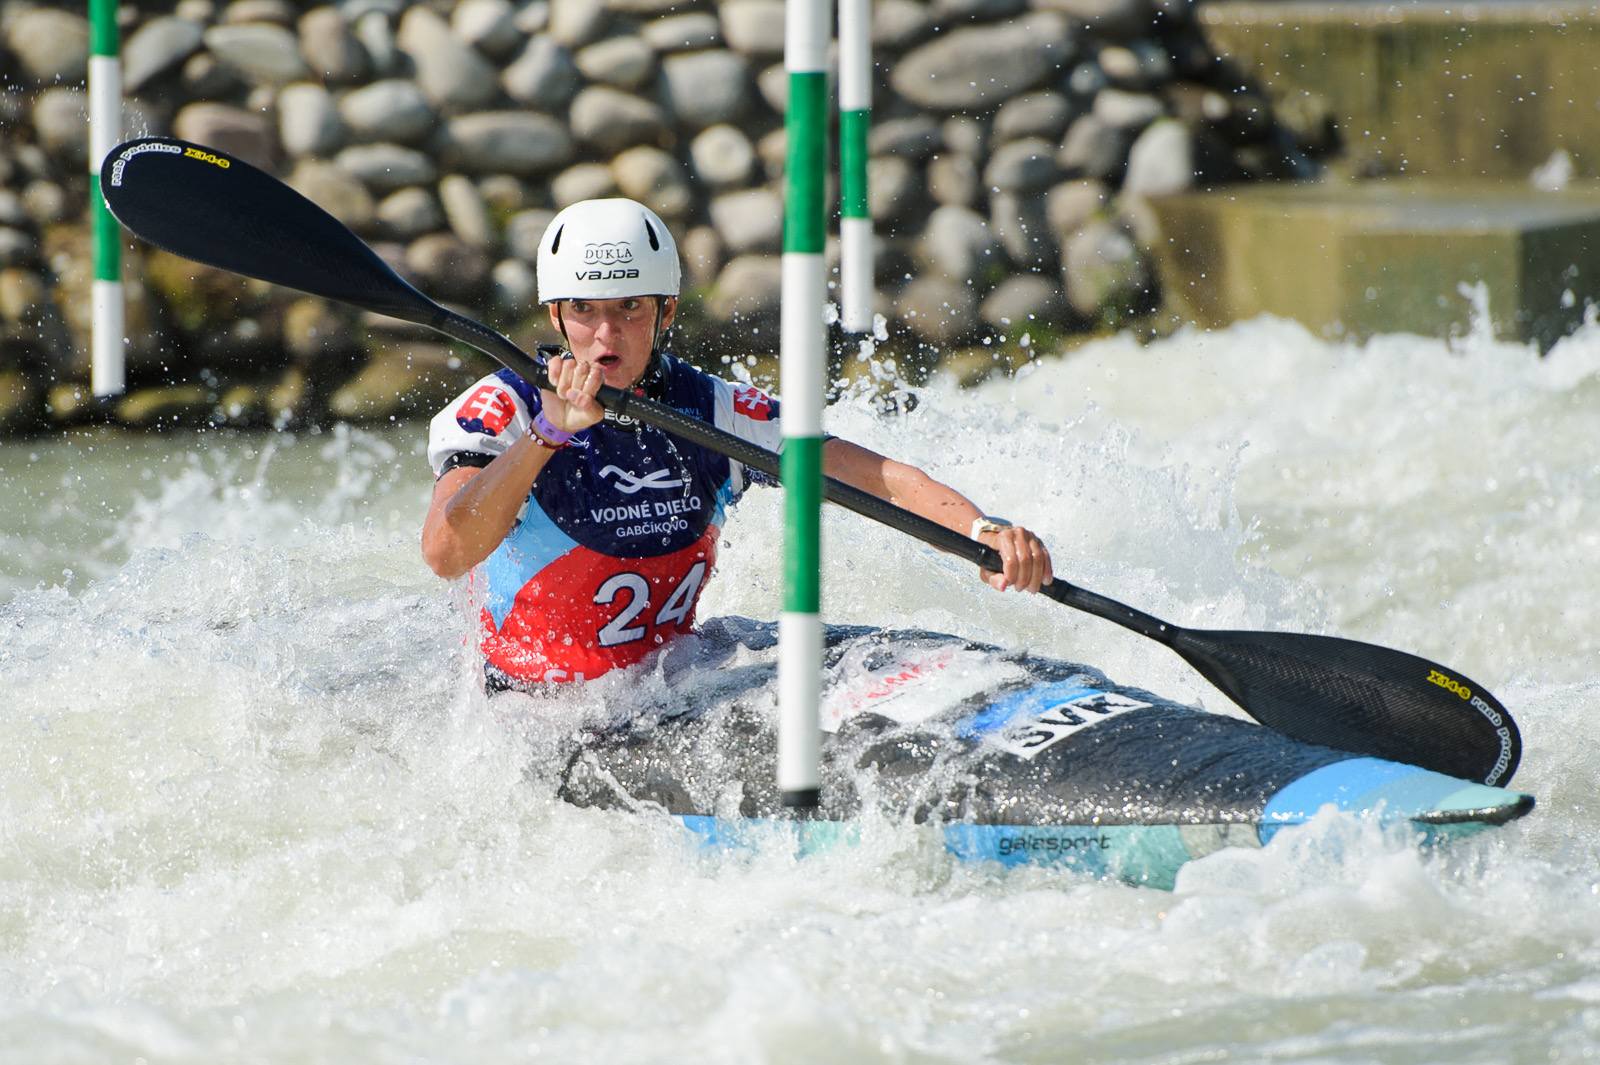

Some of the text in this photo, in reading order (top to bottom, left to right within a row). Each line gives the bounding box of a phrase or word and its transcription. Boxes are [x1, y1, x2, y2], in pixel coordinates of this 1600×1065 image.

[111, 159, 126, 187] raab
[120, 143, 182, 161] paddles
[585, 248, 633, 259] DUKLA
[590, 500, 652, 523] VODNÉ
[616, 519, 688, 538] GABČÍKOVO
[593, 559, 708, 648] 24
[1470, 695, 1502, 727] raab
[1484, 726, 1512, 786] paddles
